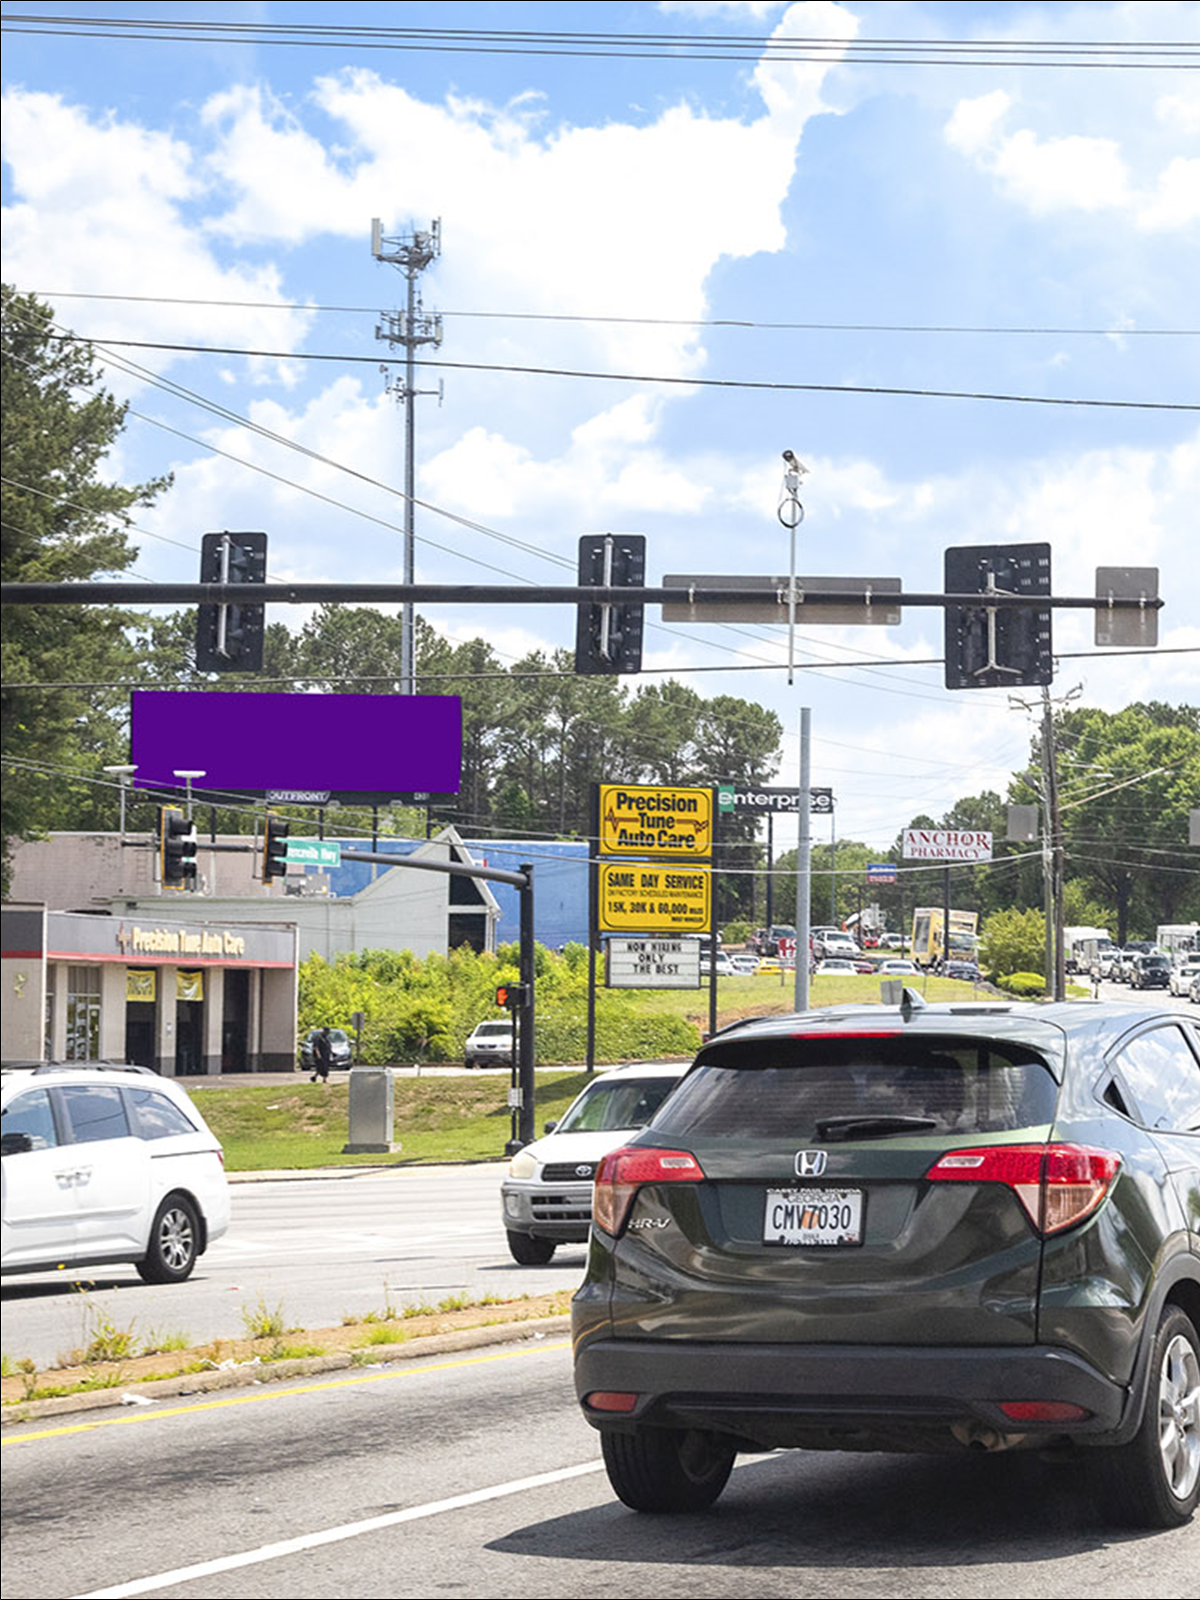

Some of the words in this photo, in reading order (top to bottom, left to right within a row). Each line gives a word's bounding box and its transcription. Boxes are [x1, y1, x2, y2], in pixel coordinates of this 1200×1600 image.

[616, 791, 698, 812] Precision
[718, 791, 831, 809] enterprse
[638, 812, 676, 829] Tune
[618, 828, 655, 848] Auto
[657, 829, 696, 849] Care
[906, 831, 991, 851] ANCHOR
[910, 846, 980, 858] PHARMACY
[608, 872, 635, 888] SAME
[641, 873, 659, 888] DAY
[665, 874, 704, 890] SERVICE
[630, 901, 647, 914] 30K
[649, 902, 656, 914] &
[658, 902, 688, 916] 60,000
[132, 926, 179, 952] Precision
[179, 929, 201, 953] Tune
[202, 930, 222, 954] Auto
[223, 930, 245, 954] Care
[627, 942, 646, 952] NOW
[638, 953, 666, 963] ONLY
[633, 964, 652, 974] THE
[655, 964, 679, 974] BEST
[628, 1217, 671, 1229] HR-V
[772, 1204, 852, 1230] CMV7030
